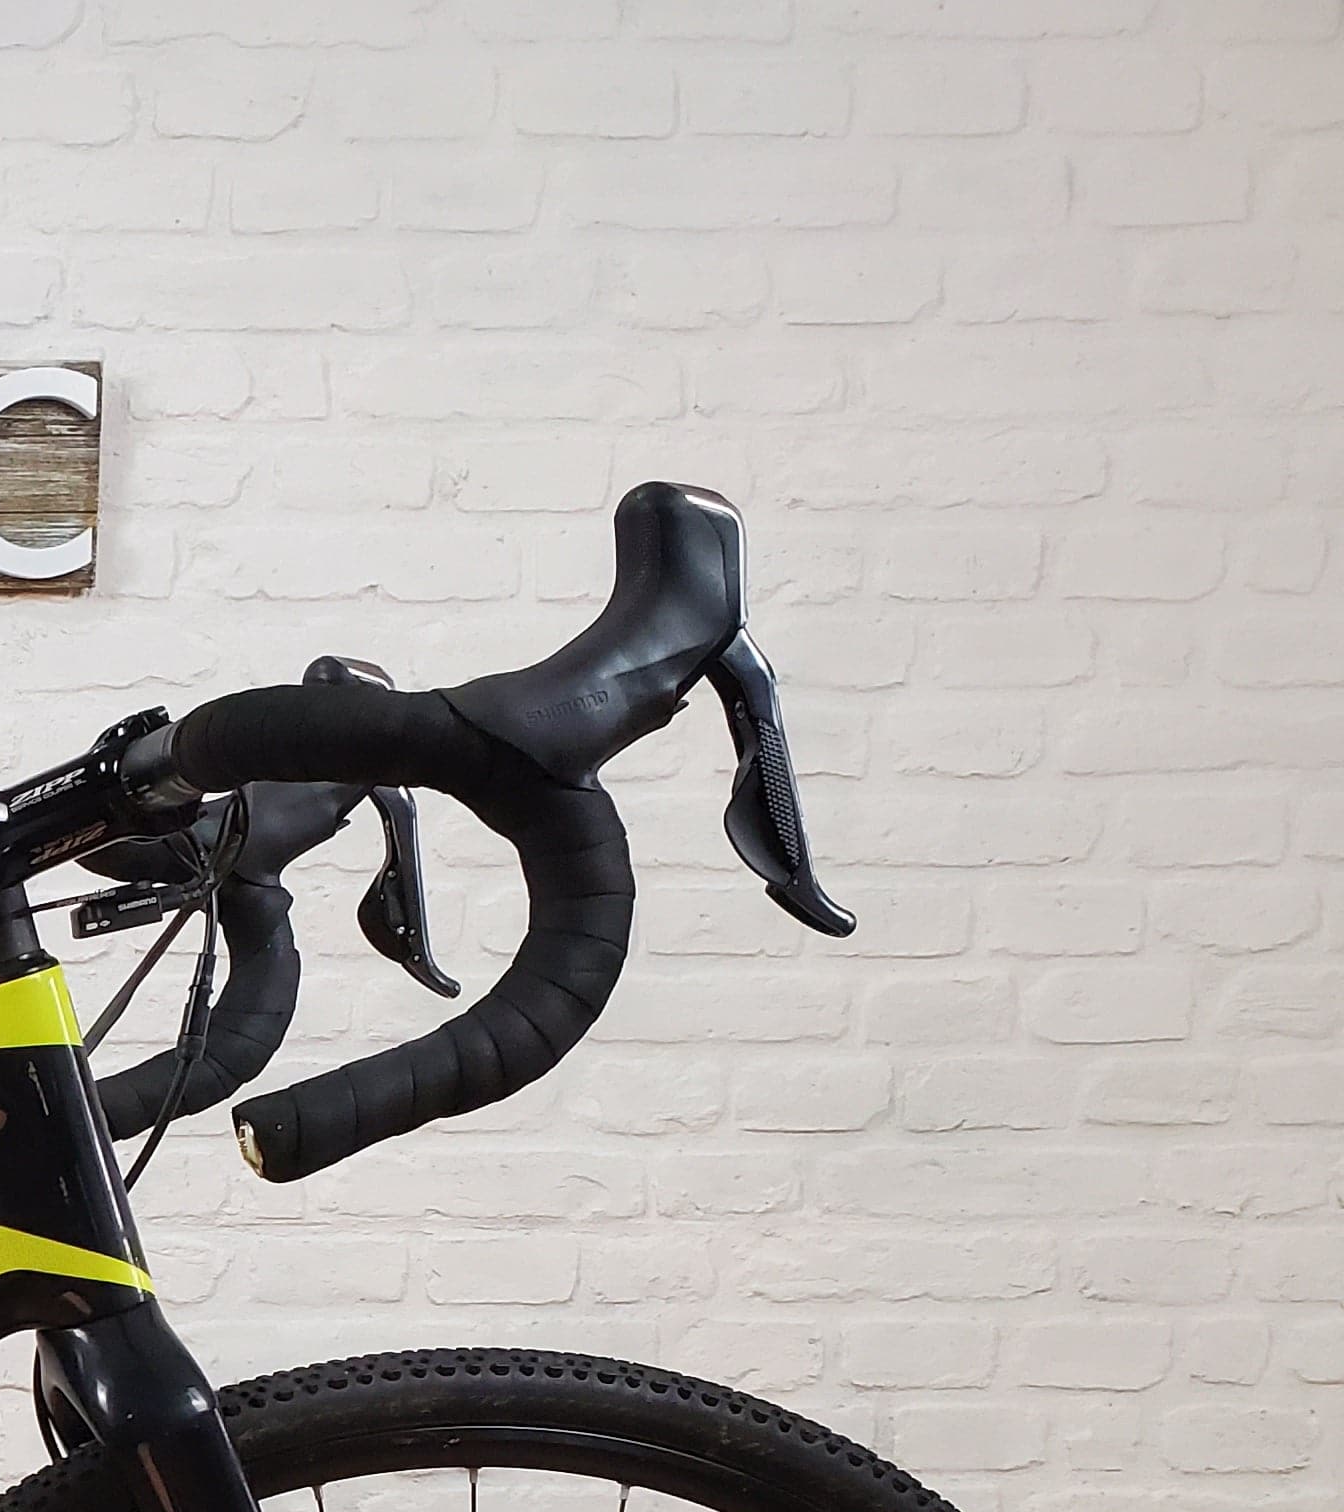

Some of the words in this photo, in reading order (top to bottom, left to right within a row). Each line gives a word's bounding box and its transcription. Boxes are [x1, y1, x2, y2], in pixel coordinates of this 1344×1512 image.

[526, 690, 609, 726] SHIMANO
[9, 767, 86, 809] ZIPP
[117, 896, 158, 912] SHIMANO
